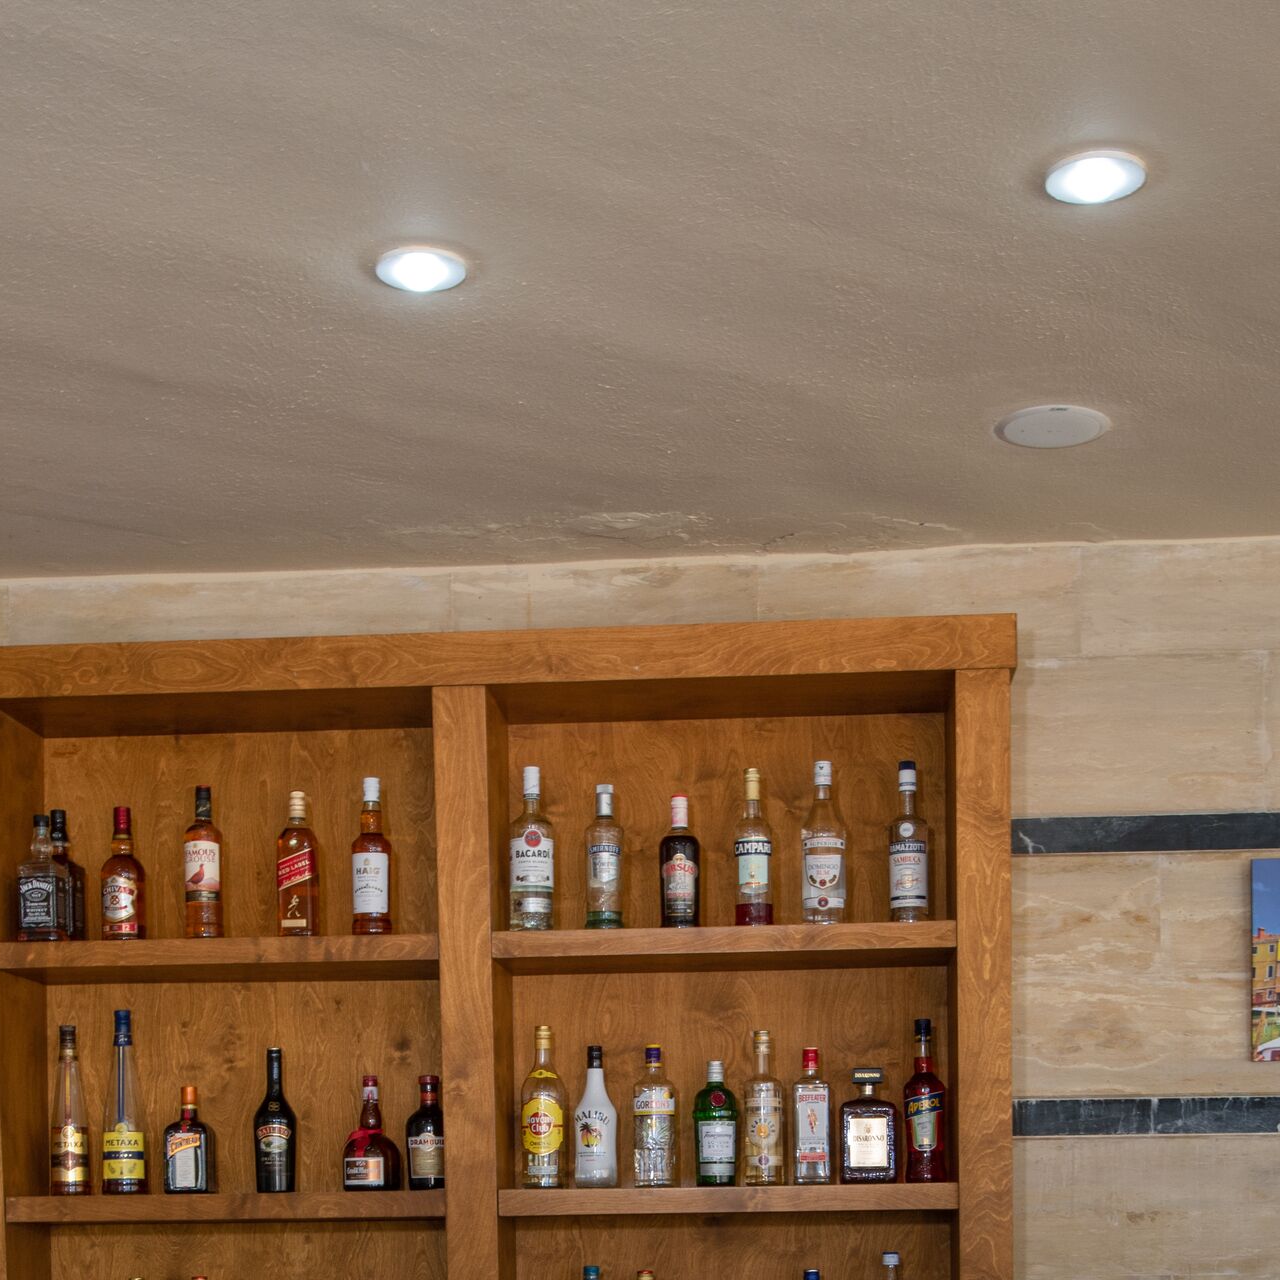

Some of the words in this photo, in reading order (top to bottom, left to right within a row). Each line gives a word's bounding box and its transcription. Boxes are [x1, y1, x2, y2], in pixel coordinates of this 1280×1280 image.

[589, 845, 619, 854] SMIRNOFF
[291, 859, 311, 870] LABEL
[355, 867, 380, 875] HAIG
[798, 1094, 826, 1103] BEEFEATER
[908, 1098, 941, 1114] APEROL
[575, 1110, 610, 1126] MALIBU
[531, 1123, 549, 1133] Club
[105, 1139, 139, 1147] METAXA
